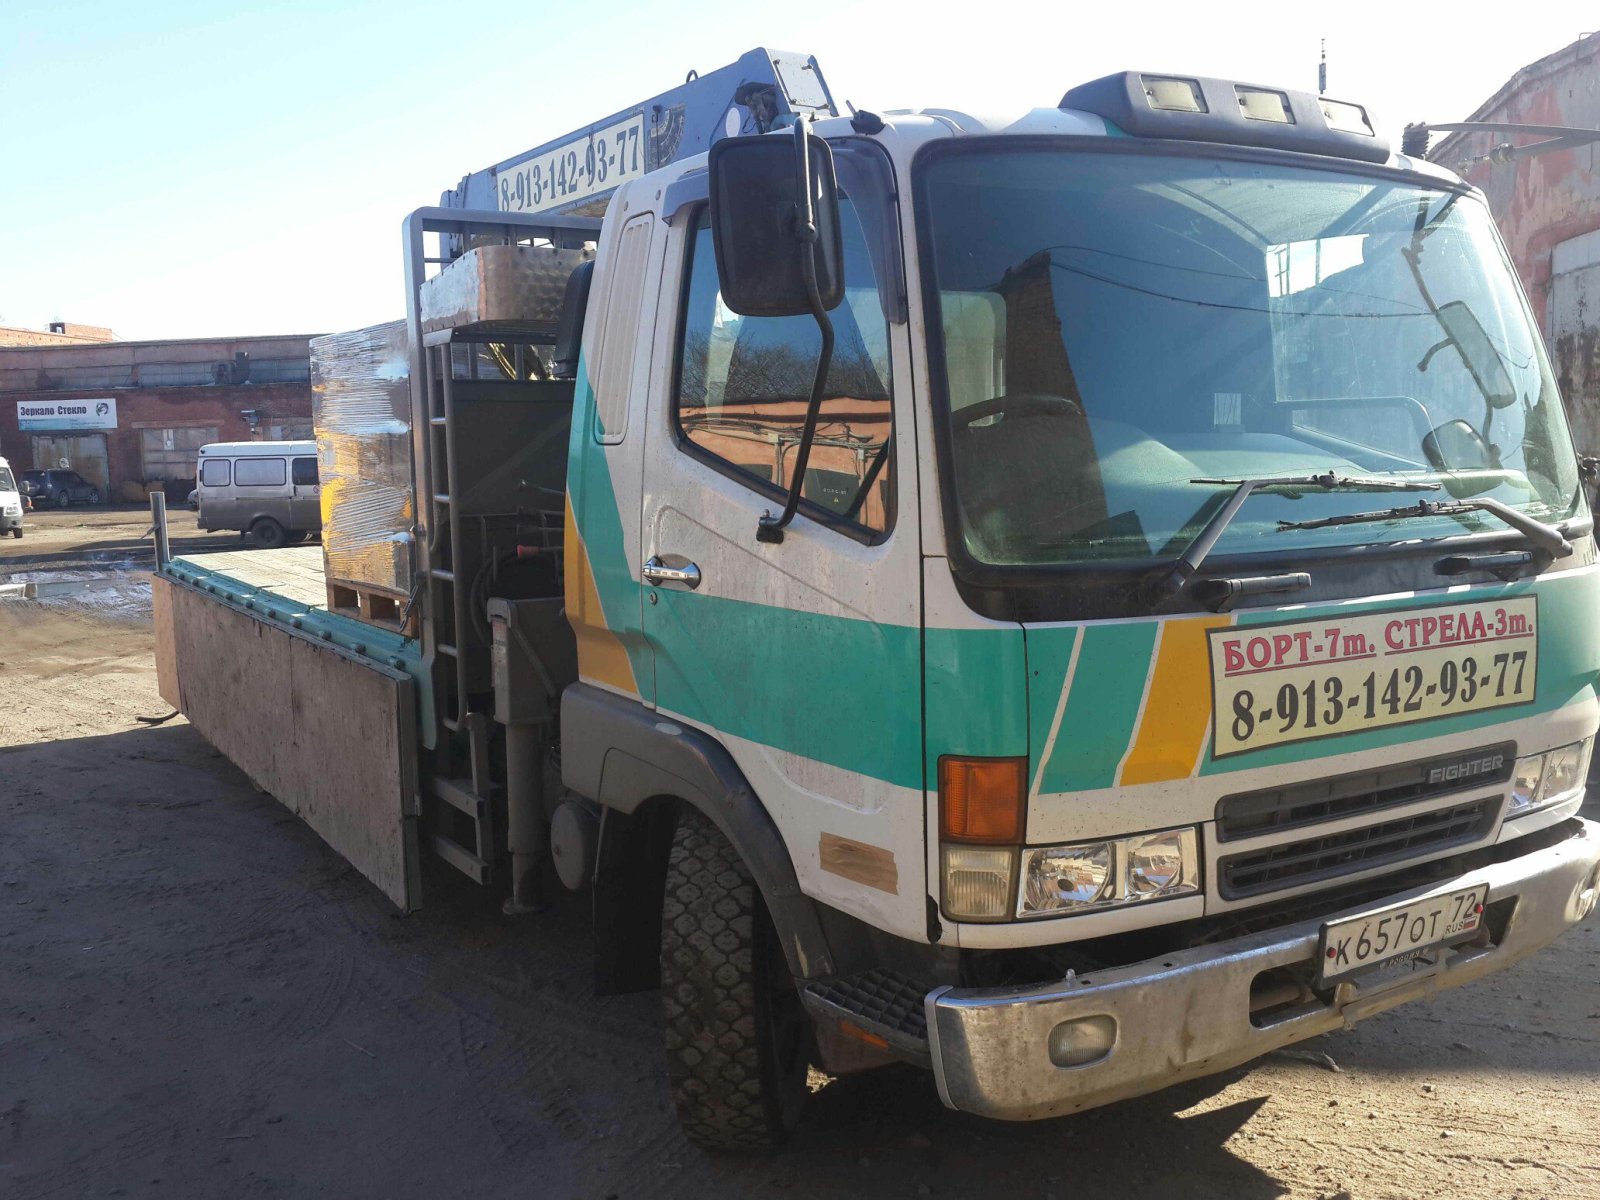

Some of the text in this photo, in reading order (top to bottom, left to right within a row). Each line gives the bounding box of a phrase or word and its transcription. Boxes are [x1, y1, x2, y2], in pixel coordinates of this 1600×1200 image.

[501, 125, 639, 212] 8-913-142-93-77
[20, 405, 87, 417] Зеркало Стекло
[1232, 651, 1528, 742] 8-913-142-93-77
[1430, 754, 1504, 784] FIGHTER
[1452, 892, 1477, 922] 72
[1445, 920, 1464, 935] RUS
